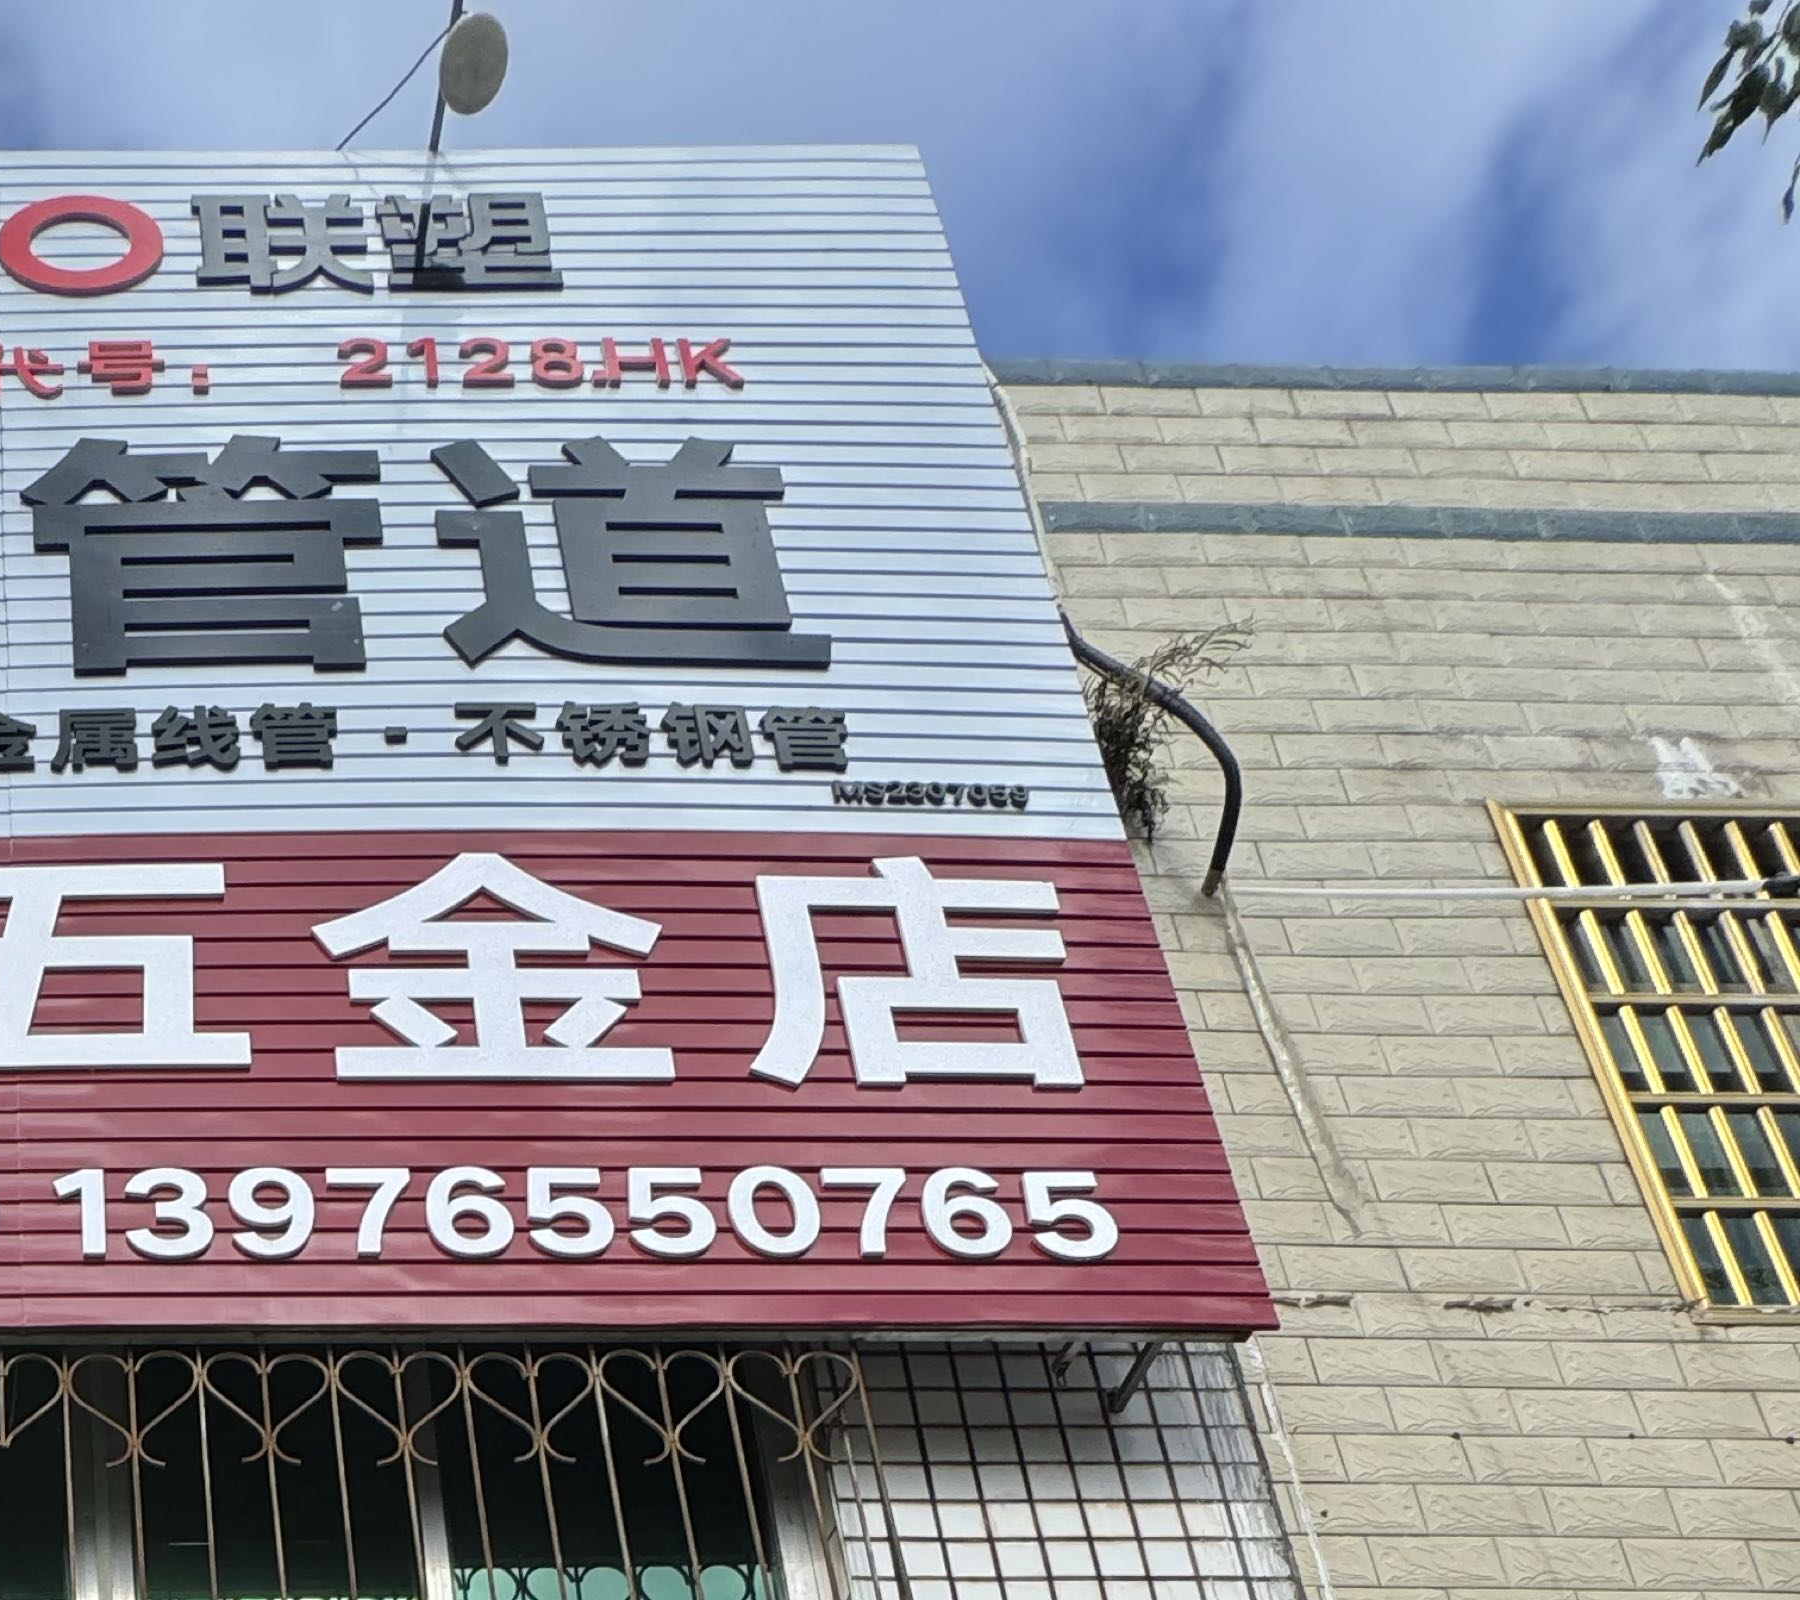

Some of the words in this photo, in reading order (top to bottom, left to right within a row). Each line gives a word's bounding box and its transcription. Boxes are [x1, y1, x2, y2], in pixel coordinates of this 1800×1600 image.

[195, 189, 564, 294] 联塑
[337, 335, 745, 393] 2128.HK
[52, 1163, 1121, 1265] 13976550765
